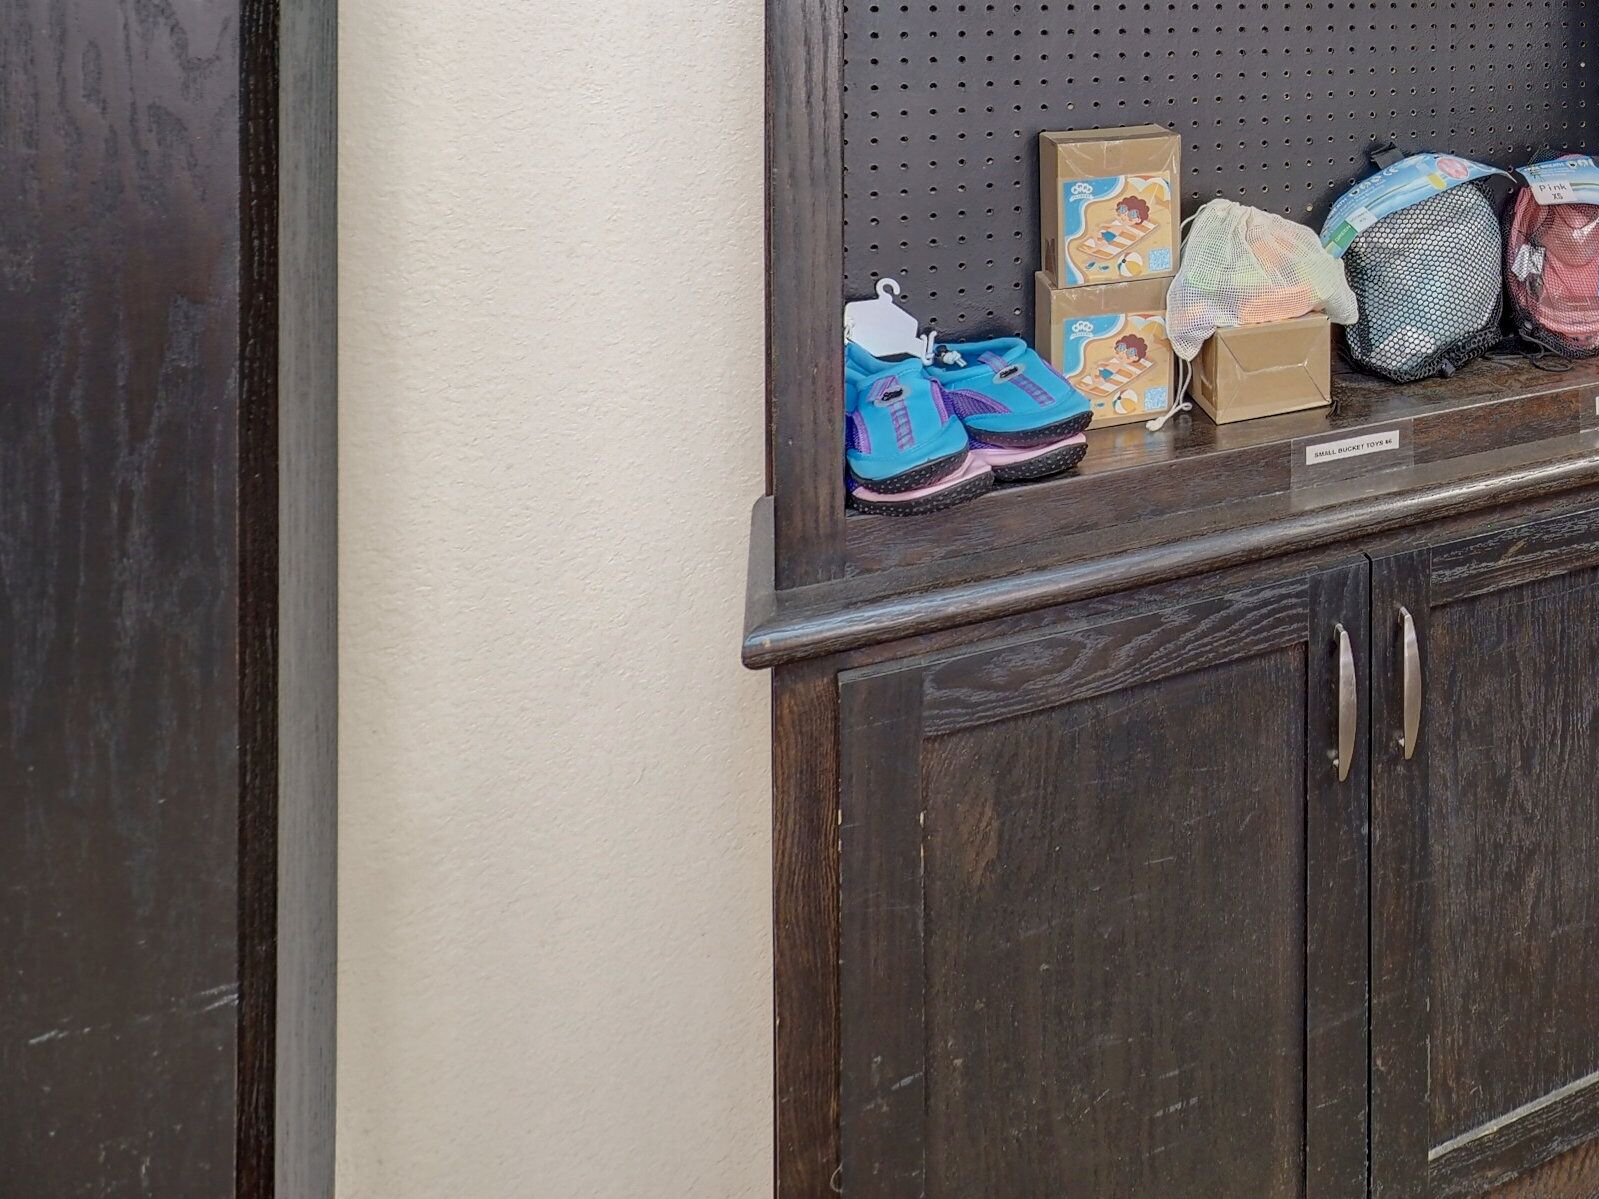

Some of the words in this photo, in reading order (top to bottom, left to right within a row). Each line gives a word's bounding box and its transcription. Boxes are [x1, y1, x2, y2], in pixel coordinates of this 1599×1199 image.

[1539, 184, 1567, 192] Pink
[1314, 449, 1337, 458] SMALL
[1337, 443, 1364, 454] BUCKET
[1366, 439, 1384, 448] TOYS
